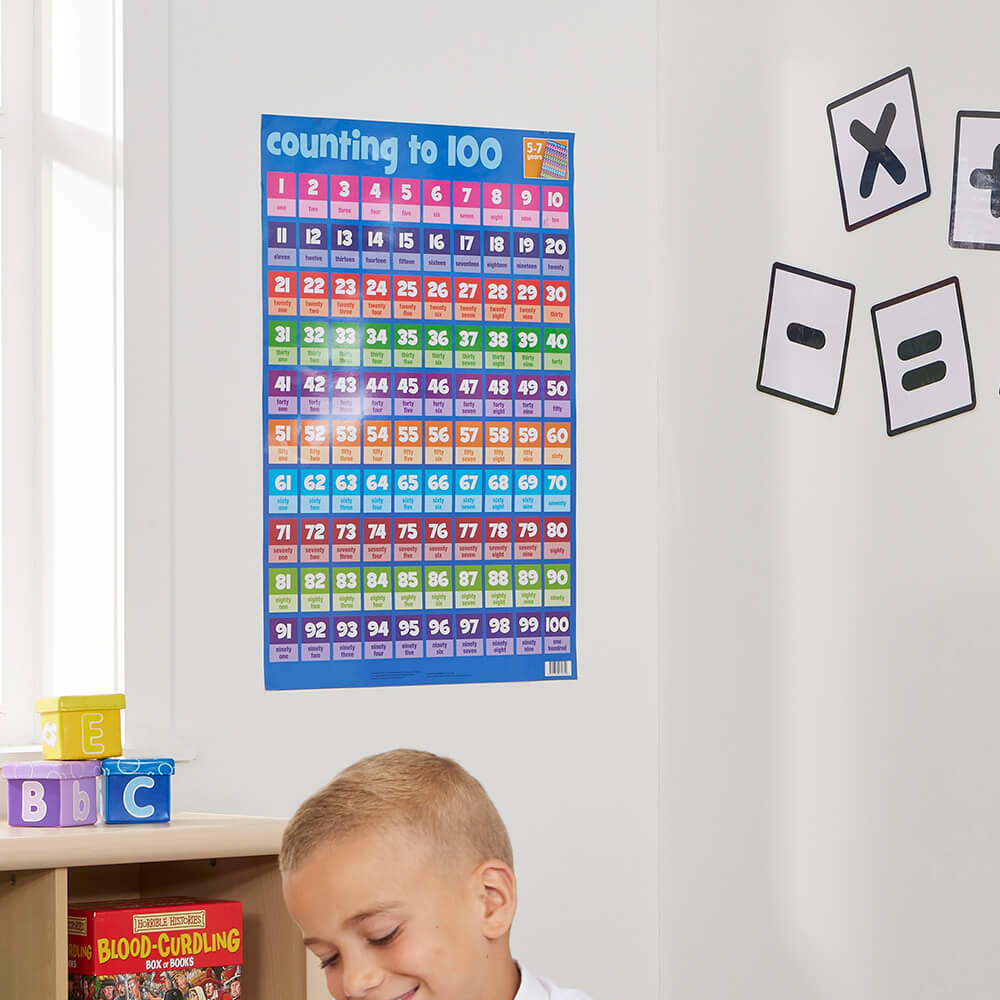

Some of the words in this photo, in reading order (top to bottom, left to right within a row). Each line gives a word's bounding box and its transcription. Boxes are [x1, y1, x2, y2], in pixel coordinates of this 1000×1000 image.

[266, 128, 398, 175] counting
[408, 134, 438, 165] to
[448, 134, 502, 170] 100
[527, 142, 543, 154] 5-7
[279, 178, 284, 194] 1
[308, 179, 319, 195] 2
[339, 180, 350, 197] 3
[369, 183, 381, 198] 4
[401, 184, 412, 200] 5
[431, 186, 442, 202] 6
[462, 187, 472, 203] 7
[491, 188, 502, 205] 8
[521, 190, 532, 205] 9
[548, 192, 563, 208] 10
[277, 227, 287, 243] 11
[306, 228, 321, 244] 12
[337, 229, 352, 246] 13
[368, 231, 384, 247] 14
[399, 232, 414, 249] 15
[429, 234, 445, 250] 16
[460, 235, 474, 250] 17
[490, 236, 504, 252] 18
[519, 237, 534, 253] 19
[545, 238, 566, 255] 20
[274, 276, 290, 293] 21
[303, 277, 325, 294] 22
[335, 278, 356, 296] 23
[366, 279, 387, 296] 24
[397, 280, 418, 297] 25
[427, 281, 448, 298] 26
[458, 282, 478, 299] 27
[488, 283, 508, 300] 28
[517, 284, 537, 300] 29
[546, 285, 567, 302] 30
[275, 326, 290, 343] 31
[304, 326, 325, 343] 32
[335, 327, 356, 345] 33
[366, 328, 388, 344] 34
[397, 329, 418, 346] 35
[428, 329, 449, 346] 36
[459, 330, 478, 347] 37
[488, 331, 508, 348] 38
[518, 332, 538, 348] 39
[546, 333, 567, 349] 40
[274, 376, 291, 392] 41
[304, 375, 326, 392] 42
[335, 376, 357, 393] 43
[366, 378, 389, 394] 44
[397, 378, 419, 394] 45
[427, 378, 449, 394] 46
[459, 379, 479, 394] 47
[488, 379, 509, 395] 48
[518, 380, 538, 395] 49
[547, 380, 567, 396] 50
[275, 425, 291, 442] 51
[304, 425, 326, 442] 52
[335, 425, 357, 442] 53
[367, 426, 389, 442] 54
[398, 426, 419, 443] 55
[428, 426, 450, 443] 56
[460, 427, 479, 443] 57
[489, 427, 509, 443] 58
[519, 427, 538, 443] 59
[547, 427, 567, 444] 60
[275, 474, 291, 491] 61
[304, 474, 326, 491] 62
[335, 474, 357, 491] 63
[366, 474, 389, 491] 64
[397, 474, 419, 491] 65
[428, 474, 449, 490] 66
[459, 475, 479, 490] 67
[488, 474, 509, 490] 68
[518, 474, 538, 490] 69
[547, 475, 567, 491] 70
[276, 524, 291, 540] 71
[305, 523, 325, 540] 72
[336, 523, 356, 540] 73
[368, 524, 386, 539] 74
[398, 523, 418, 539] 75
[428, 523, 448, 539] 76
[459, 523, 478, 538] 77
[489, 522, 508, 538] 78
[518, 522, 538, 538] 79
[547, 522, 568, 538] 80
[275, 573, 291, 590] 81
[304, 572, 326, 590] 82
[336, 572, 357, 589] 83
[366, 572, 388, 588] 84
[398, 571, 418, 588] 85
[428, 571, 449, 587] 86
[459, 571, 478, 587] 87
[488, 570, 509, 586] 88
[518, 570, 539, 586] 89
[547, 569, 568, 585] 90
[275, 623, 292, 639] 91
[305, 622, 326, 638] 92
[337, 621, 358, 638] 93
[367, 621, 389, 636] 94
[398, 620, 420, 636] 95
[429, 619, 450, 635] 96
[460, 619, 479, 634] 97
[489, 618, 510, 634] 98
[519, 617, 539, 632] 99
[546, 616, 568, 632] 100
[81, 712, 105, 755] E
[21, 780, 47, 822] B
[72, 780, 91, 822] b
[123, 776, 155, 818] C
[137, 917, 168, 929] HORRIBLE
[97, 928, 241, 964] BLOOD-CURDLING
[145, 959, 162, 970] BOX
[169, 957, 195, 967] BOOKS
